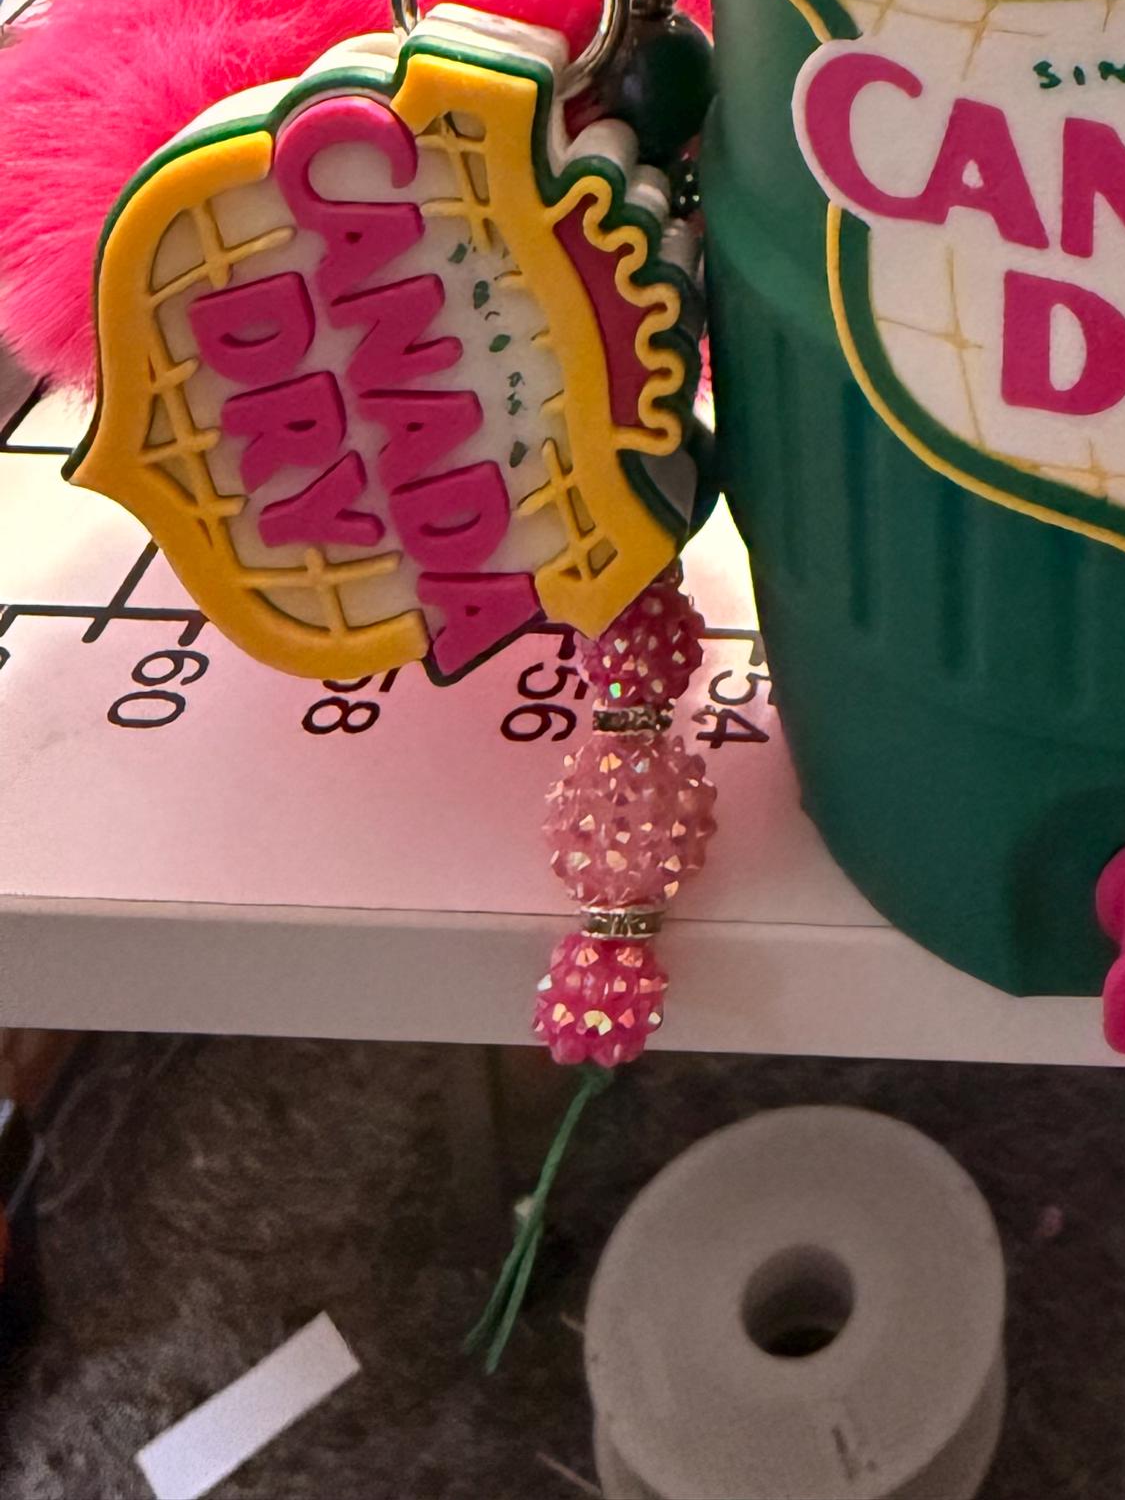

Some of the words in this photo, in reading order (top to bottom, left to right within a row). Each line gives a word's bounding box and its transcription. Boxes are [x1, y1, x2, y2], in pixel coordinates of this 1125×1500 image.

[187, 271, 386, 548] DRY
[273, 95, 546, 676] CANADA
[106, 649, 210, 729] 60
[500, 661, 589, 742] 56
